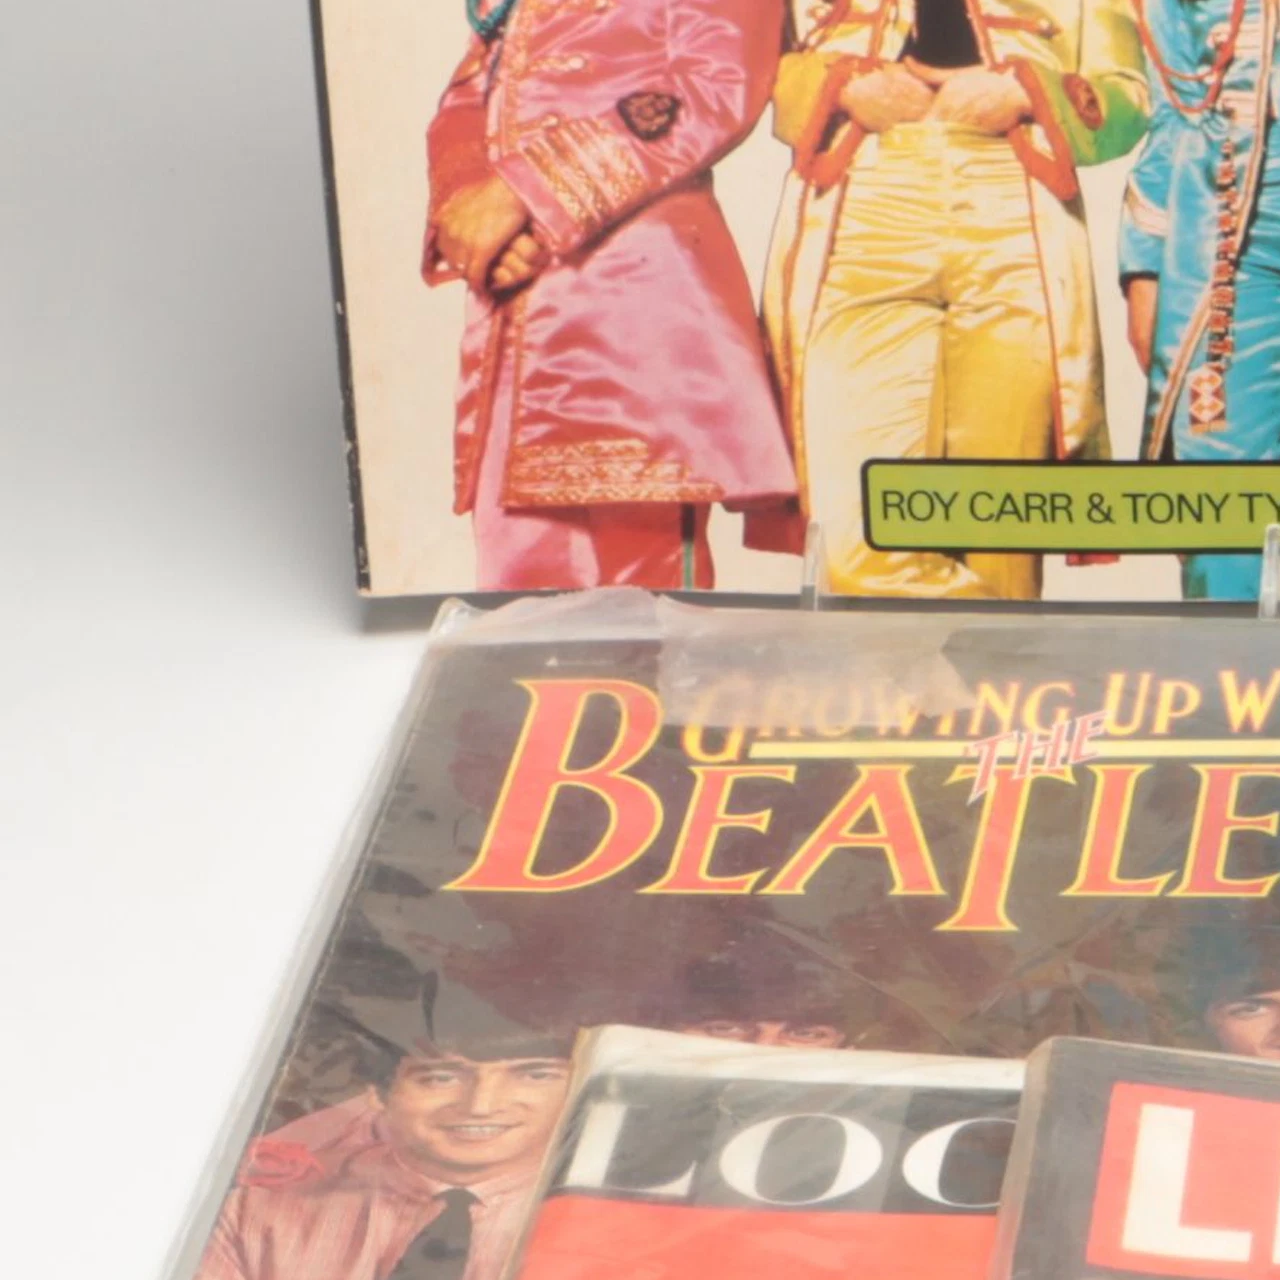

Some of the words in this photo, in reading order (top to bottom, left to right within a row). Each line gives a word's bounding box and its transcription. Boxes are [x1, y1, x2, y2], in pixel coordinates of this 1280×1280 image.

[880, 490, 960, 522] ROY
[968, 491, 1074, 522] CARR
[1086, 493, 1114, 523] &
[1122, 493, 1232, 524] TONY
[681, 671, 1077, 764] GROWING
[1102, 671, 1201, 737] UP
[963, 706, 1111, 806] THE
